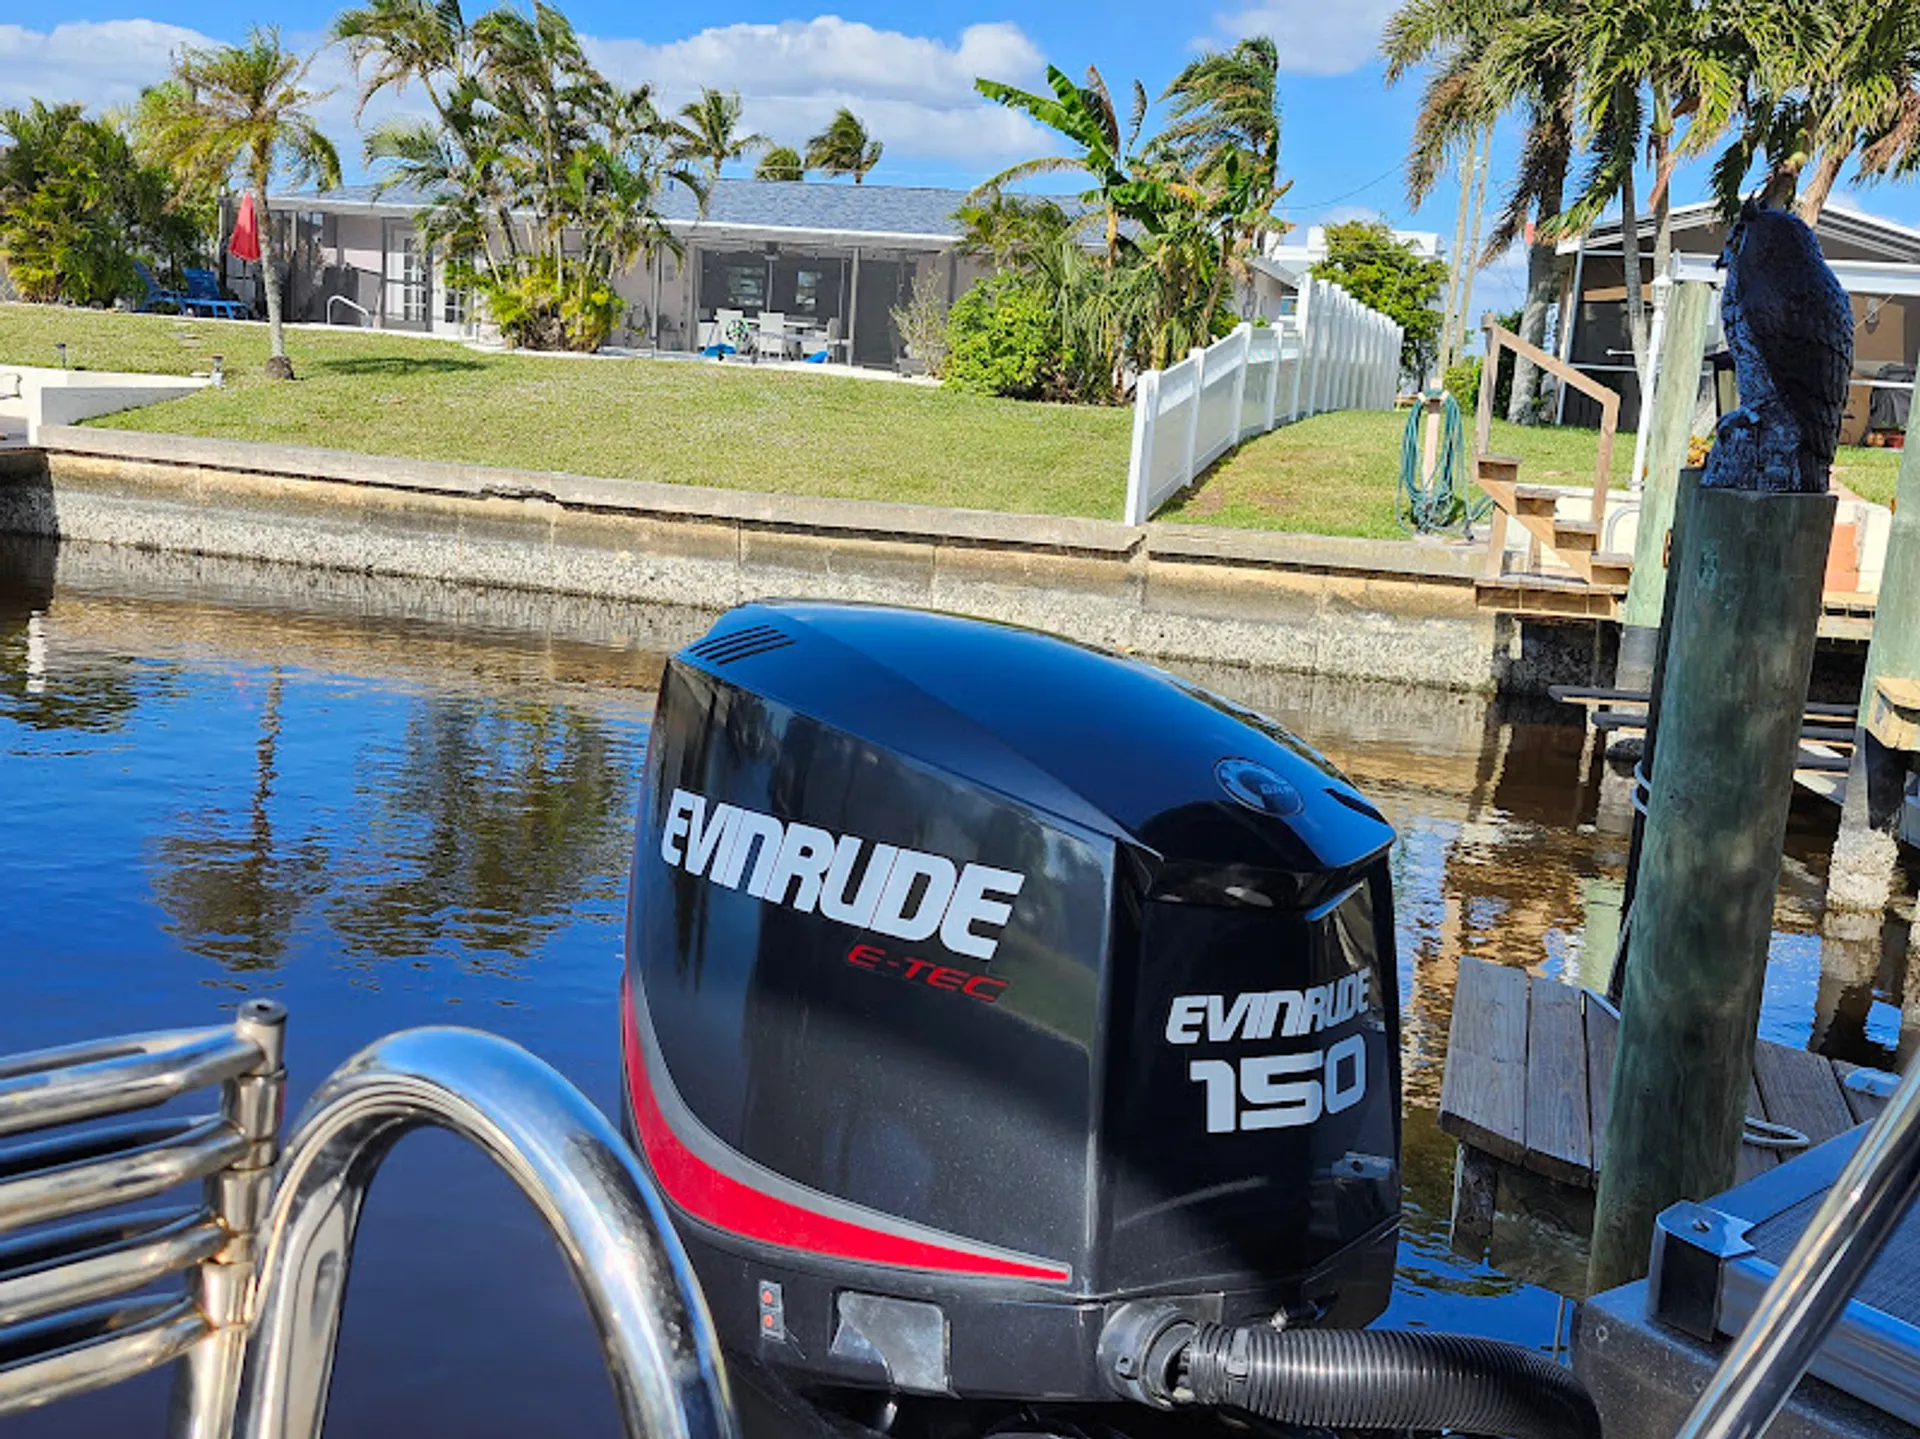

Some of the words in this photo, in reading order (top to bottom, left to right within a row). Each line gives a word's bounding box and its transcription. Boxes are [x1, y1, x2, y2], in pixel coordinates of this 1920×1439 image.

[661, 788, 1025, 960] EVINRUDE
[847, 944, 1009, 1002] E-TEC
[1165, 967, 1371, 1045] EVINRUDE
[1189, 1033, 1366, 1133] 150
